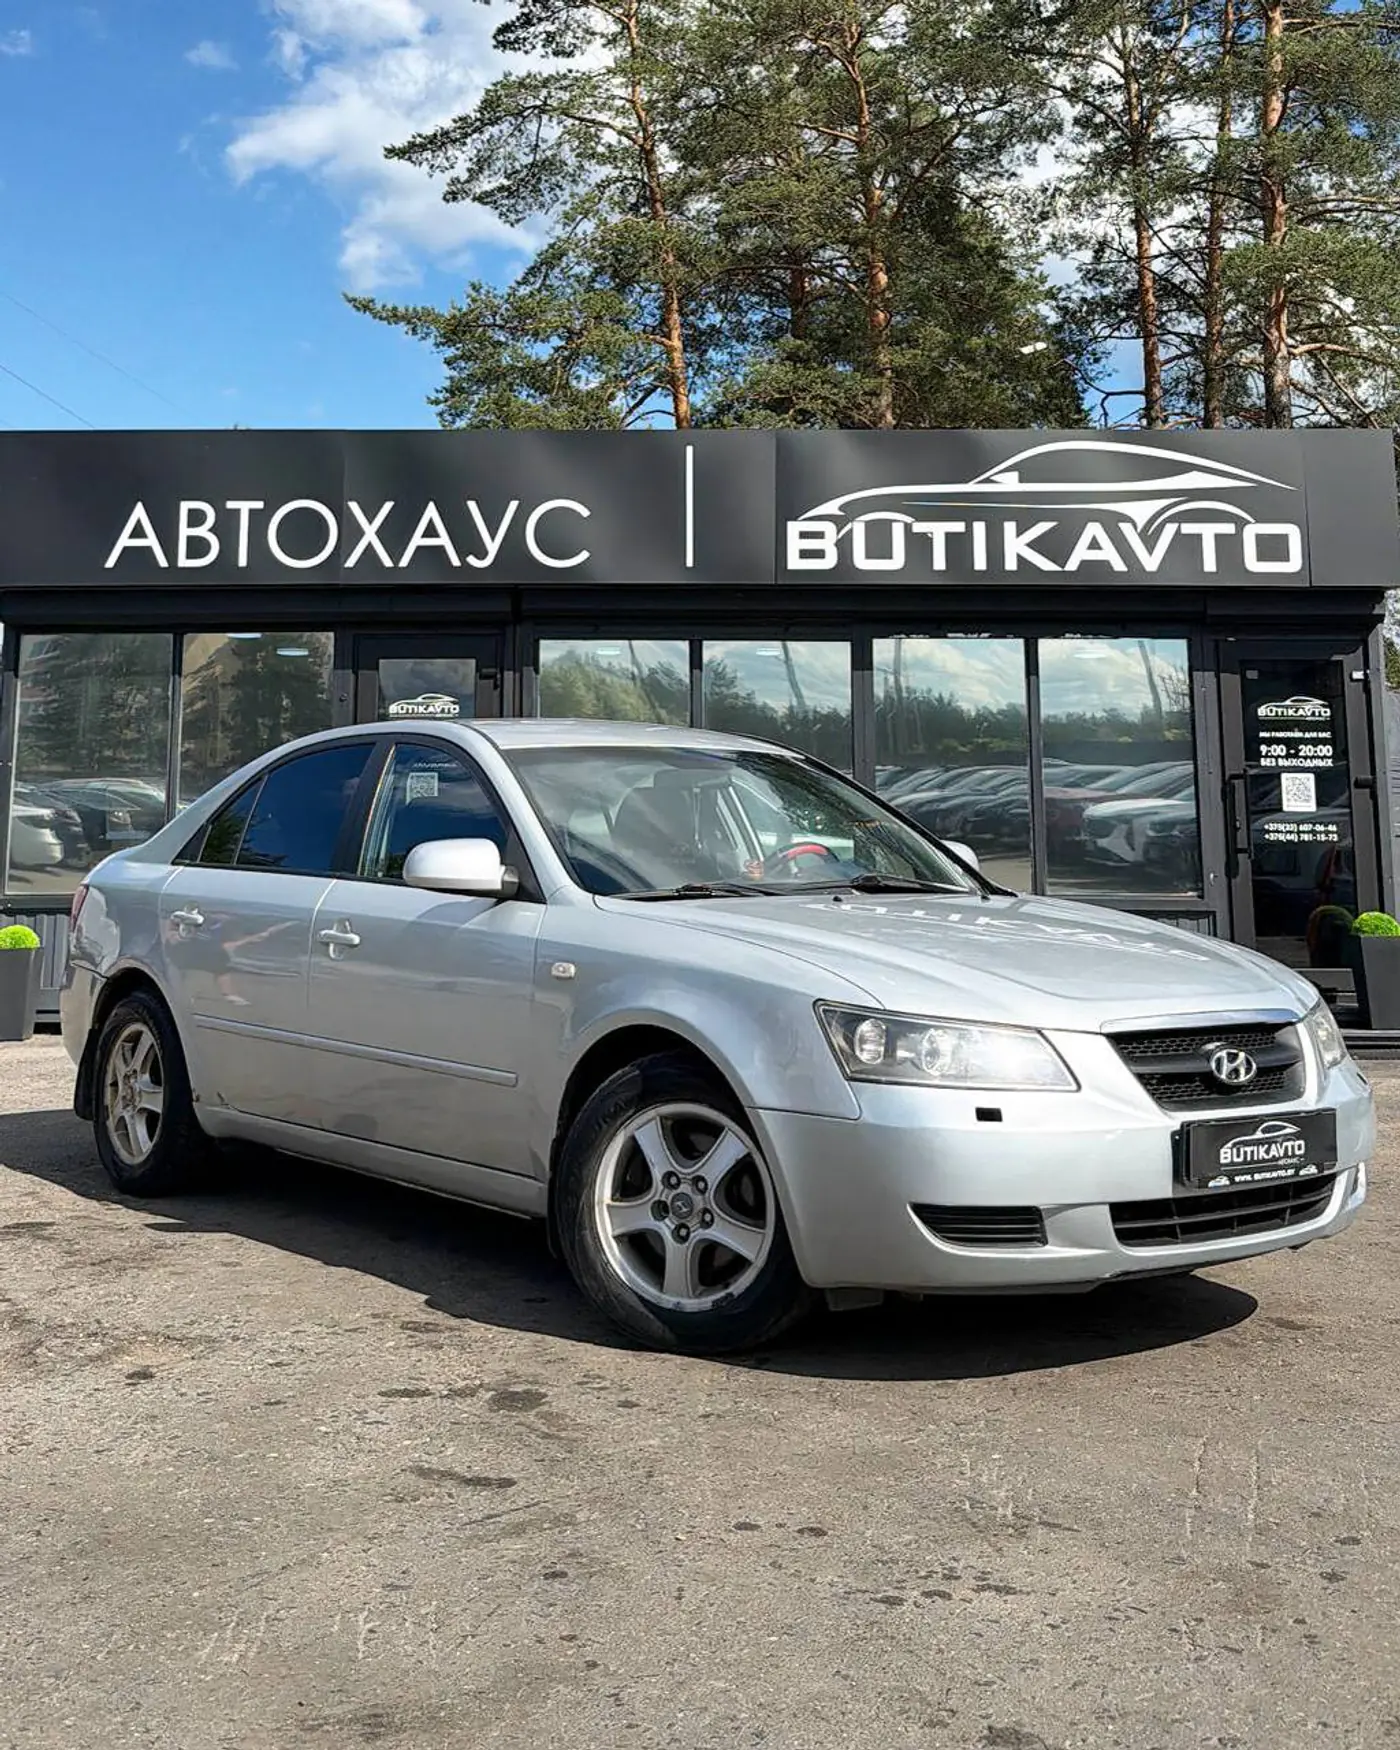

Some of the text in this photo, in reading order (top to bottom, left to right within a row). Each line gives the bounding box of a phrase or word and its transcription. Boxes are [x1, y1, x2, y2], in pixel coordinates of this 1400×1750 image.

[104, 499, 591, 568] АВТОХАУС
[785, 521, 1303, 573] BUTIKAVTO
[388, 704, 460, 714] BUTIKAVTO
[1257, 706, 1331, 717] BUTIKAVTO
[1260, 744, 1287, 756] 9:00
[1298, 744, 1333, 757] 20:00
[1260, 758, 1334, 767] БЕЗ ВЫХОДНЫХ
[1219, 1140, 1305, 1164] BUTIKAVTO
